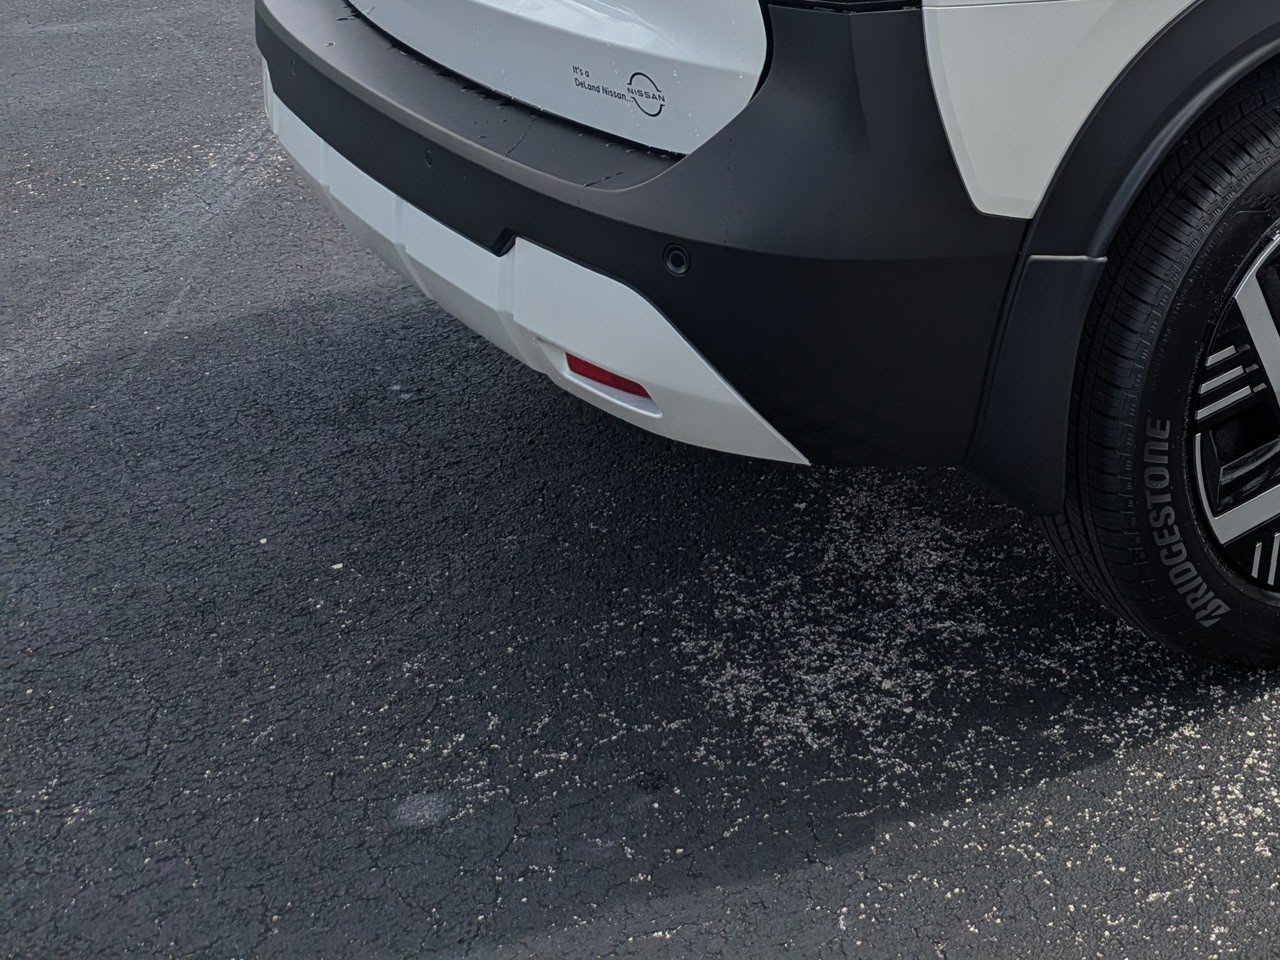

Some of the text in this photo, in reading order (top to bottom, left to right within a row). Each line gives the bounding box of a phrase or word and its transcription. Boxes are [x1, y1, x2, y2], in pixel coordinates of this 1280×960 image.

[572, 65, 584, 76] It's
[574, 77, 601, 94] DeLand
[626, 86, 666, 103] NISSAN
[1144, 416, 1231, 628] BRIDGESTONE
